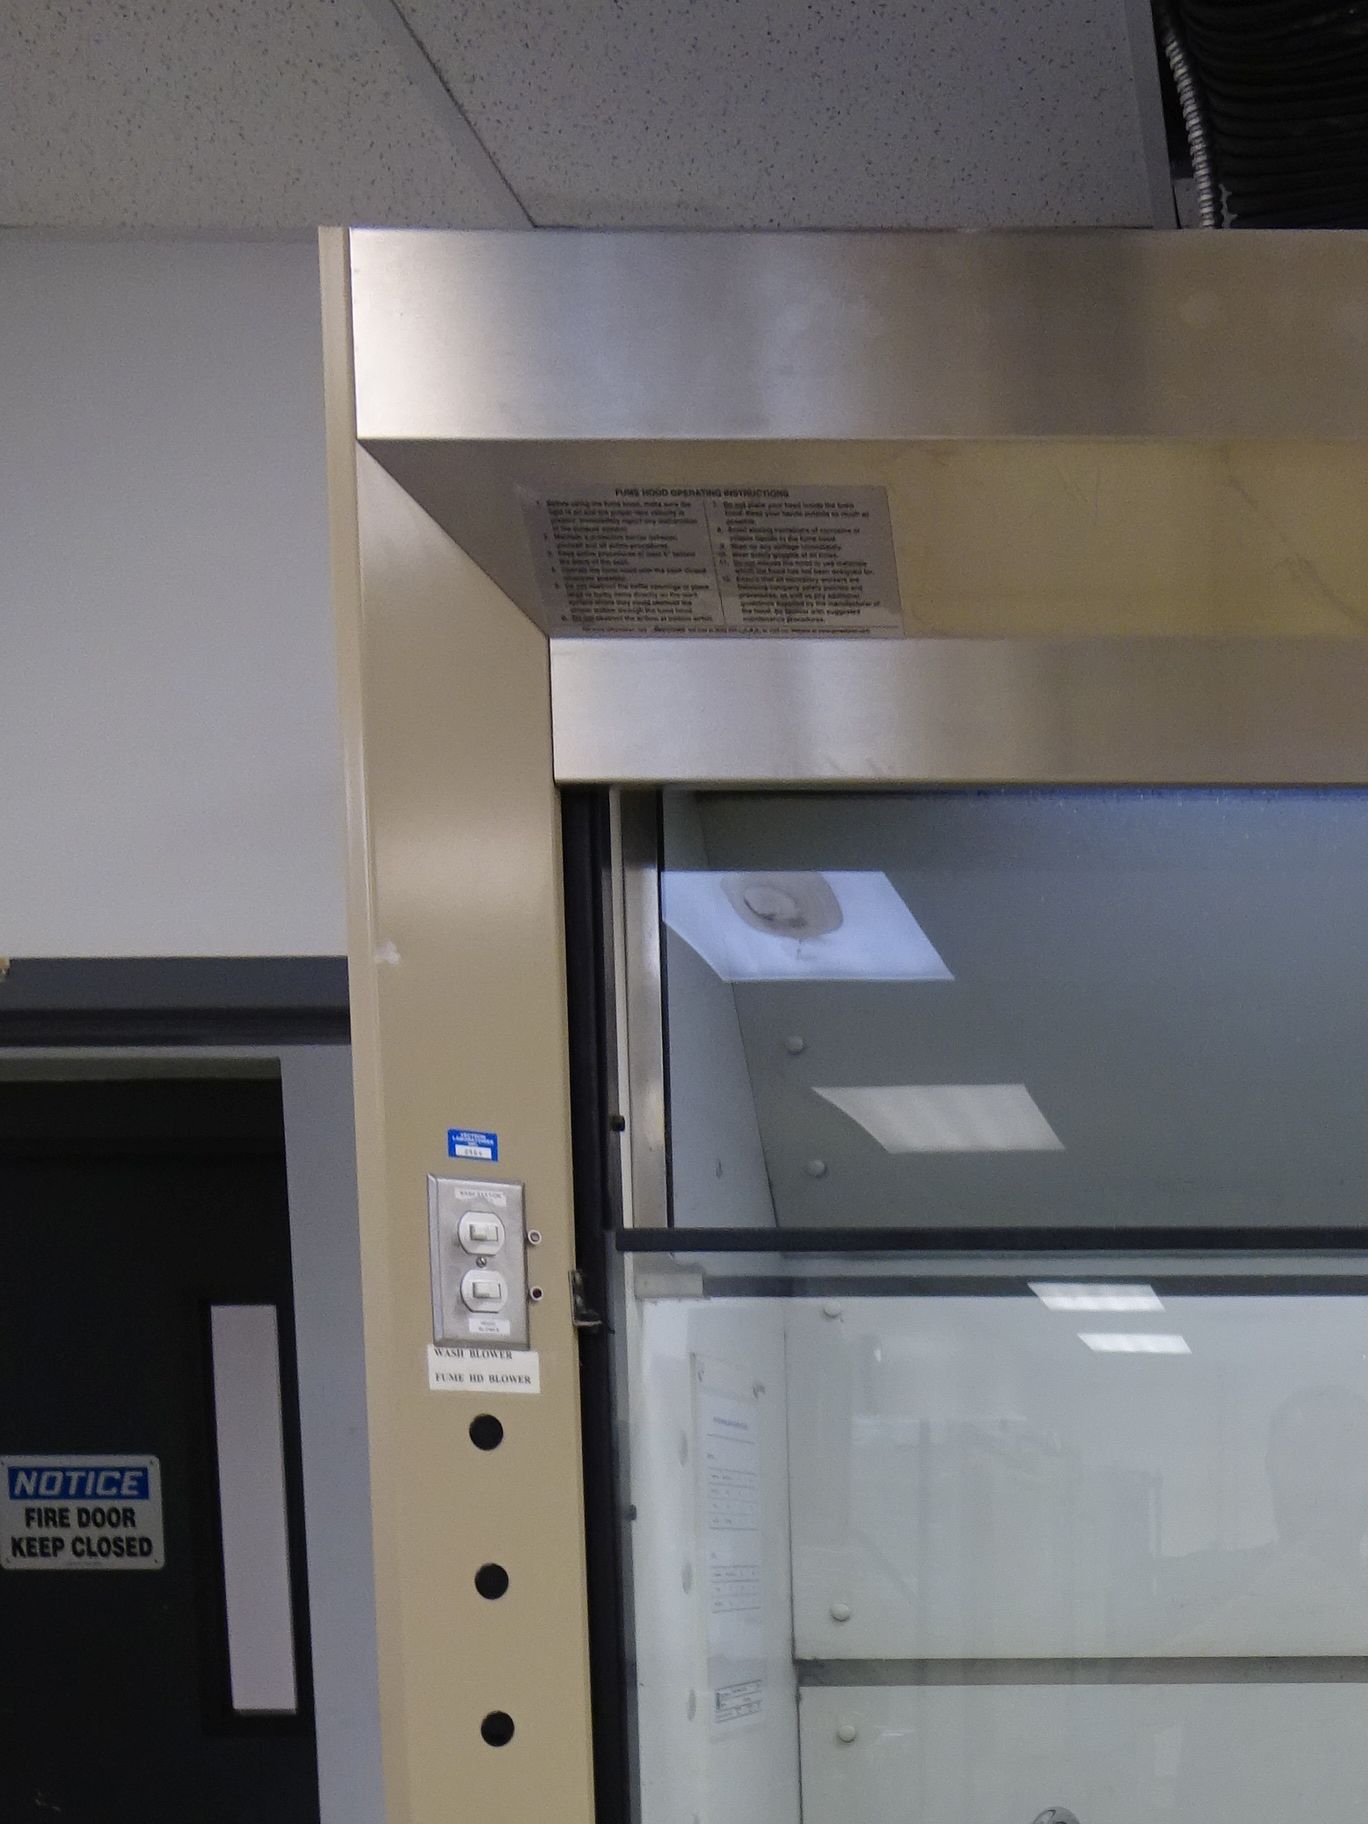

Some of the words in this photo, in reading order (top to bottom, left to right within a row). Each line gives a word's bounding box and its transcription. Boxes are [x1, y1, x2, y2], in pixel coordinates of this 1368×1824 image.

[642, 488, 668, 497] HOOD
[670, 488, 721, 497] OPERATING
[723, 489, 790, 498] INSTRUCTIONS
[434, 1348, 464, 1358] WASH
[469, 1348, 512, 1360] BLOWER
[435, 1372, 464, 1383] FUME
[469, 1373, 484, 1383] HD
[489, 1374, 531, 1385] BLOWER
[14, 1470, 143, 1497] NOTICE
[25, 1507, 70, 1529] FIRE
[77, 1507, 136, 1529] DOOR
[11, 1536, 65, 1558] KEEP
[71, 1536, 153, 1558] CLOSED
